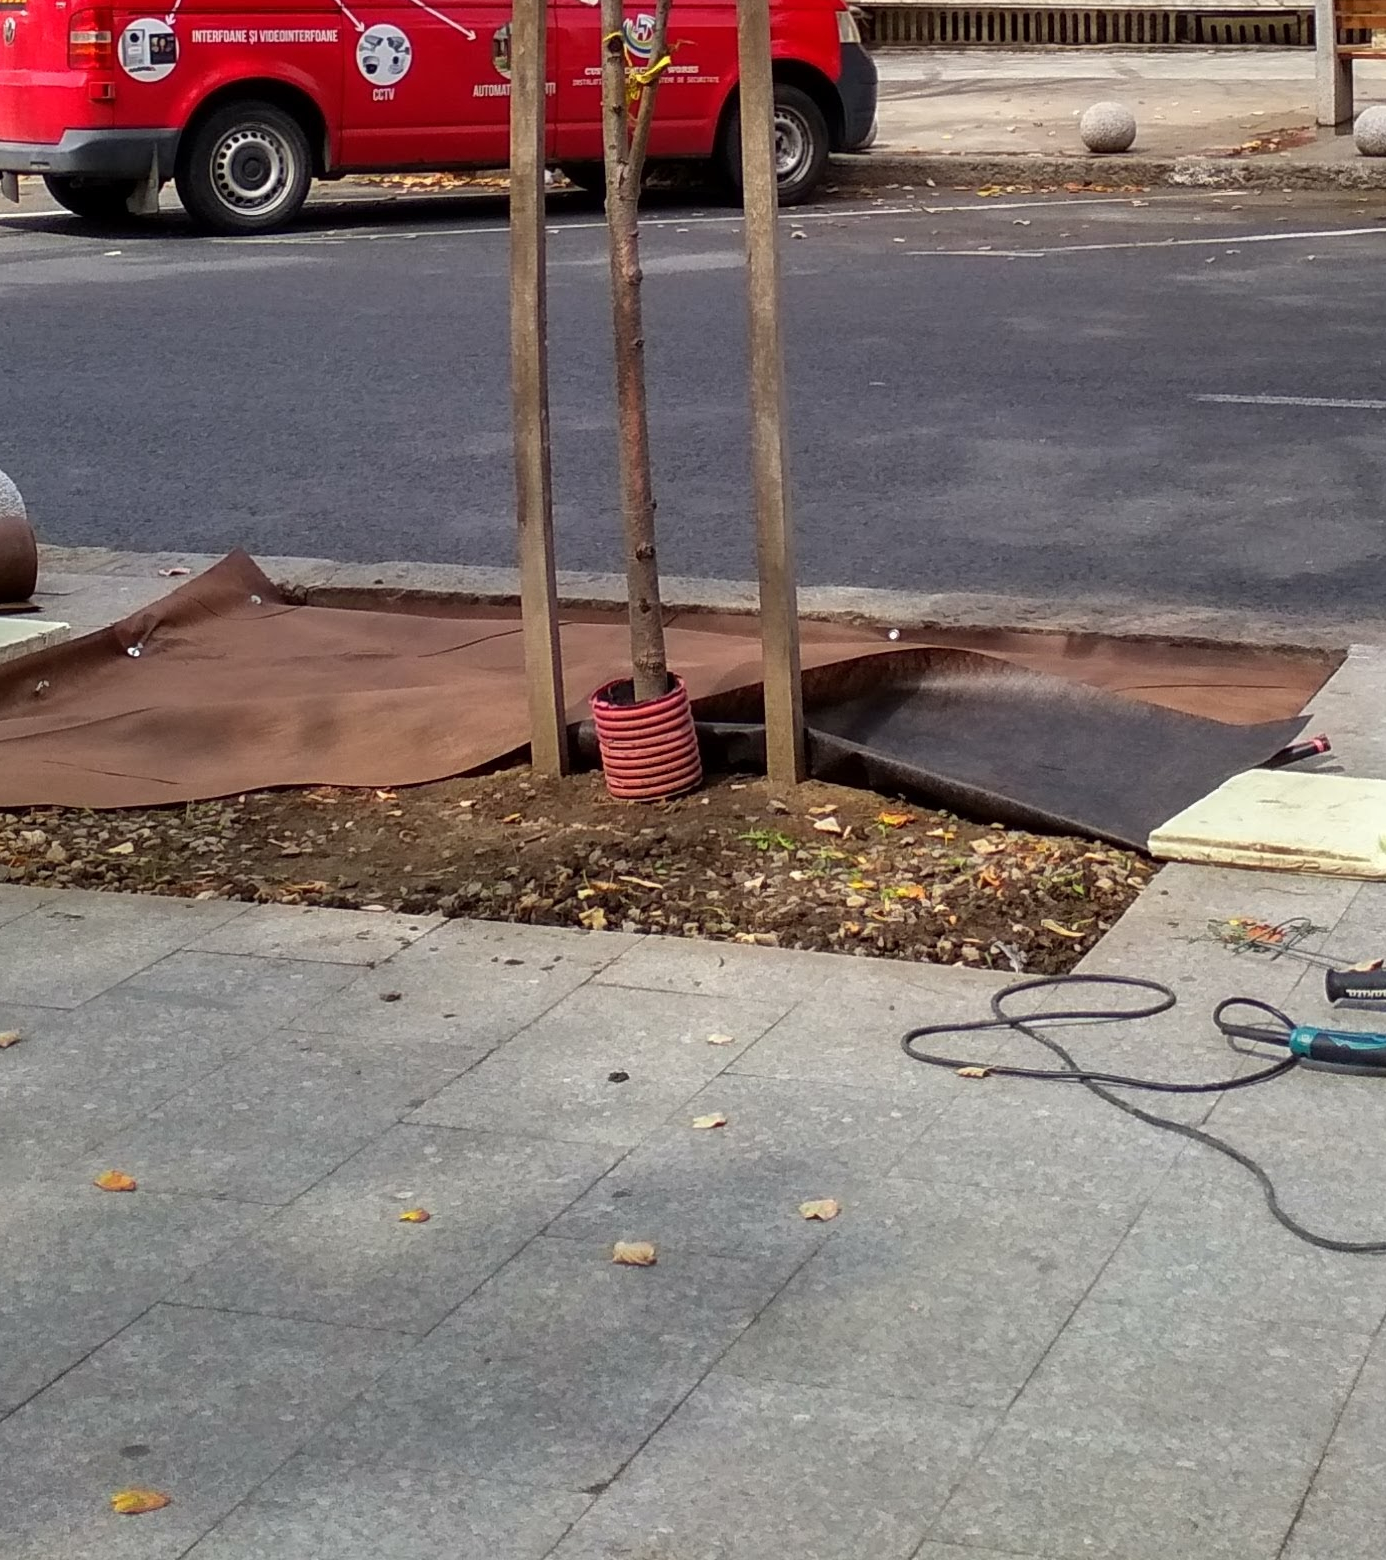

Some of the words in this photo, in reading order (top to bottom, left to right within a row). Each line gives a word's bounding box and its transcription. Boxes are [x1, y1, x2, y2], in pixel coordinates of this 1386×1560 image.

[192, 30, 247, 43] INTERFOANE
[259, 30, 338, 43] VIDEOINTERFOANE
[373, 88, 395, 101] CCTV
